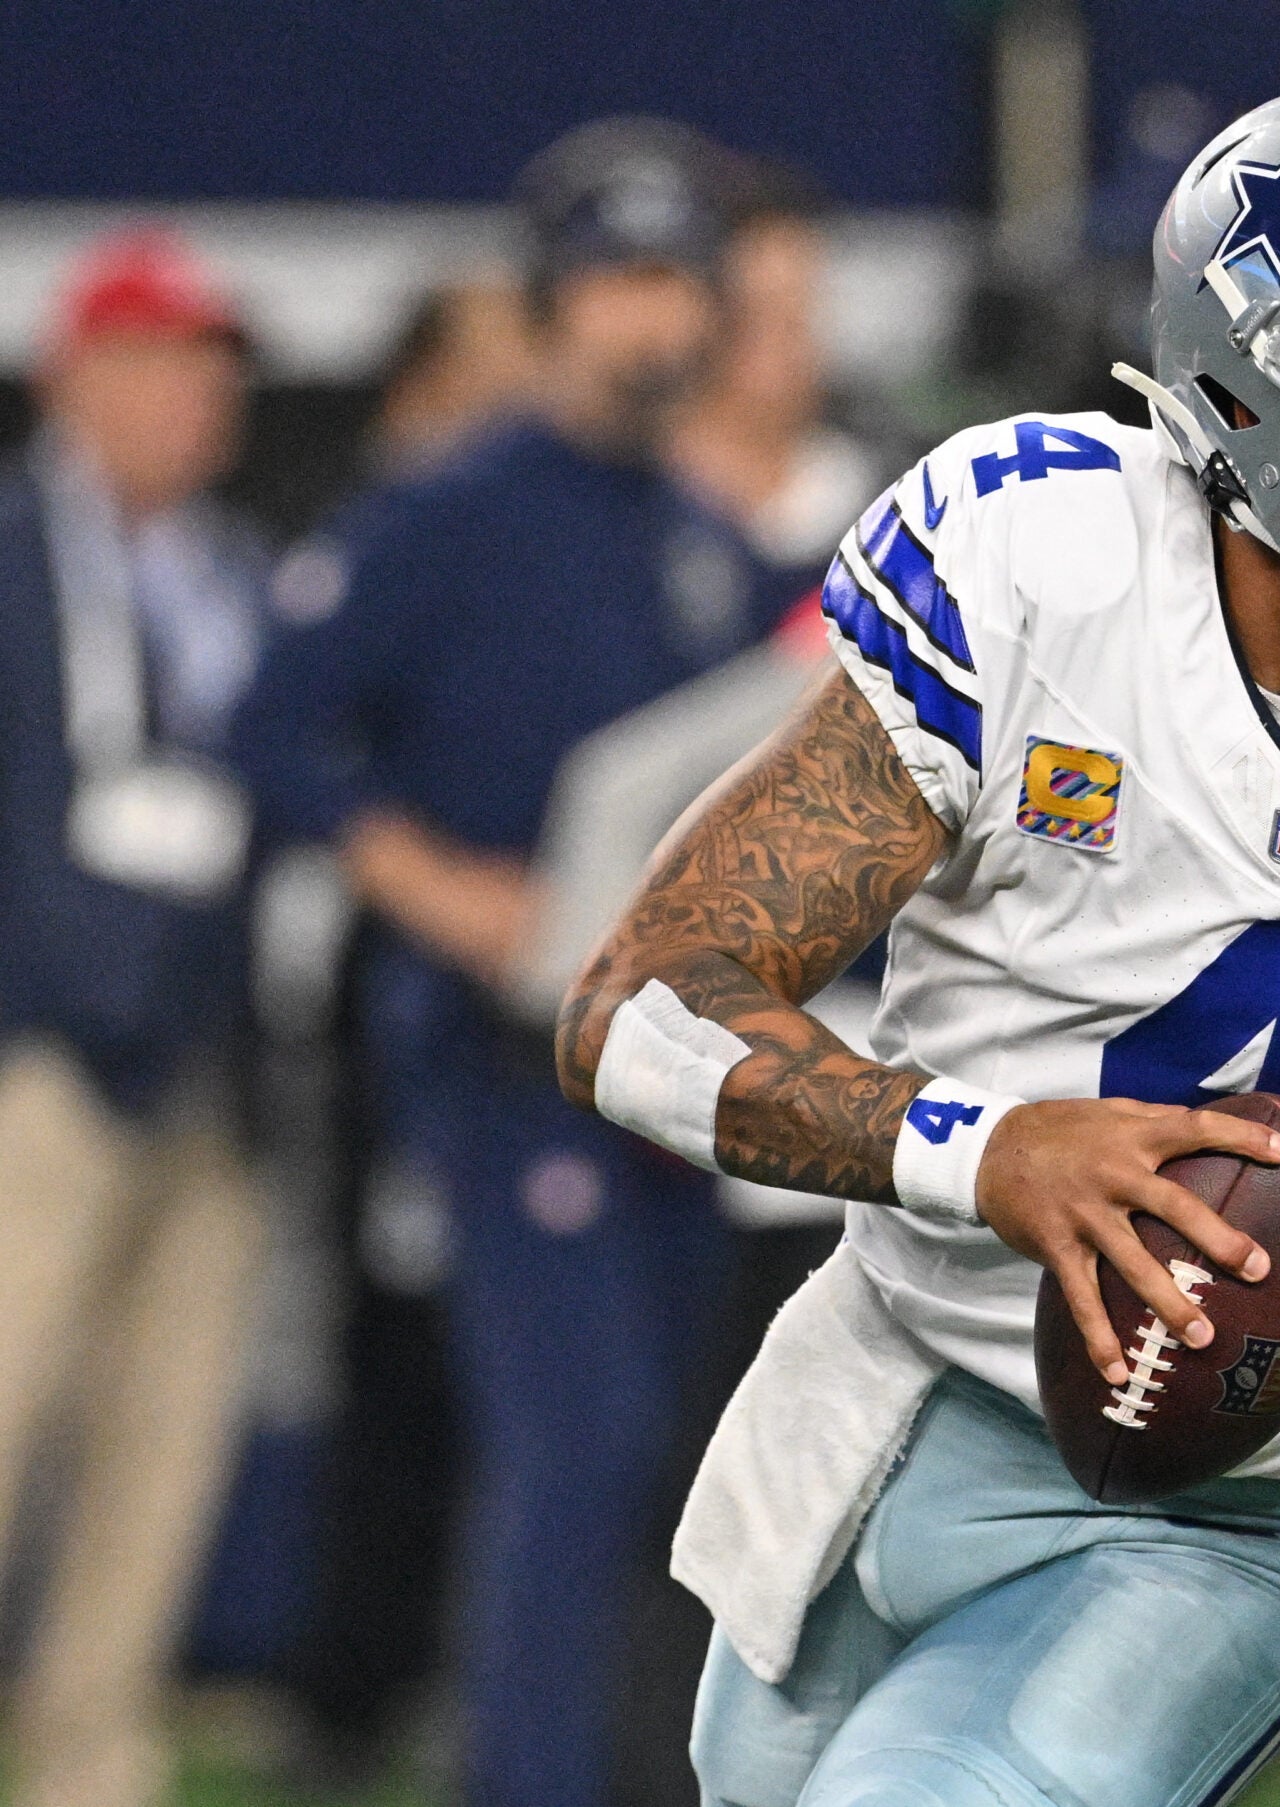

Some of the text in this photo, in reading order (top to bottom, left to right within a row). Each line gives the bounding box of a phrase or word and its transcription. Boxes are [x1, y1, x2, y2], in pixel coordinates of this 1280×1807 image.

[971, 421, 1122, 498] 4
[1026, 744, 1118, 823] C
[906, 1098, 985, 1145] 4
